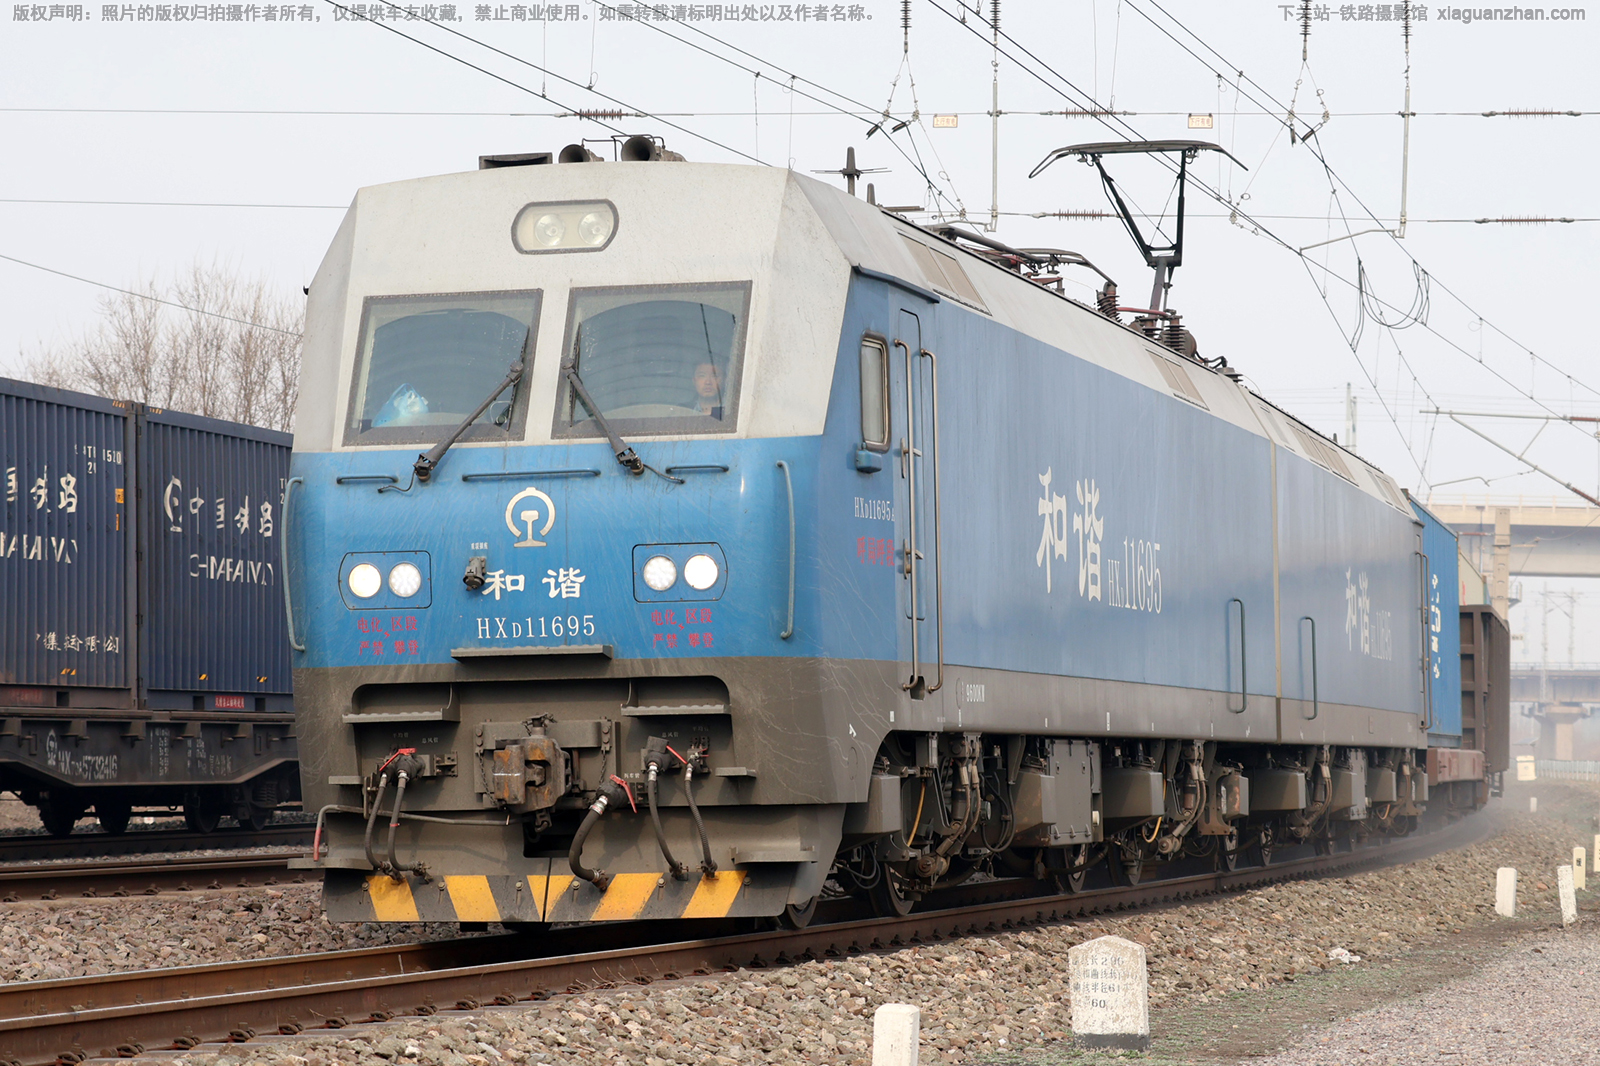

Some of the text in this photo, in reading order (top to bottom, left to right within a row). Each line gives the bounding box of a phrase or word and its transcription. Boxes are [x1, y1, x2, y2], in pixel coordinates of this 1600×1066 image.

[1036, 466, 1104, 602] 和谐
[1107, 535, 1163, 614] HXD11695
[476, 615, 595, 639] HXD11695
